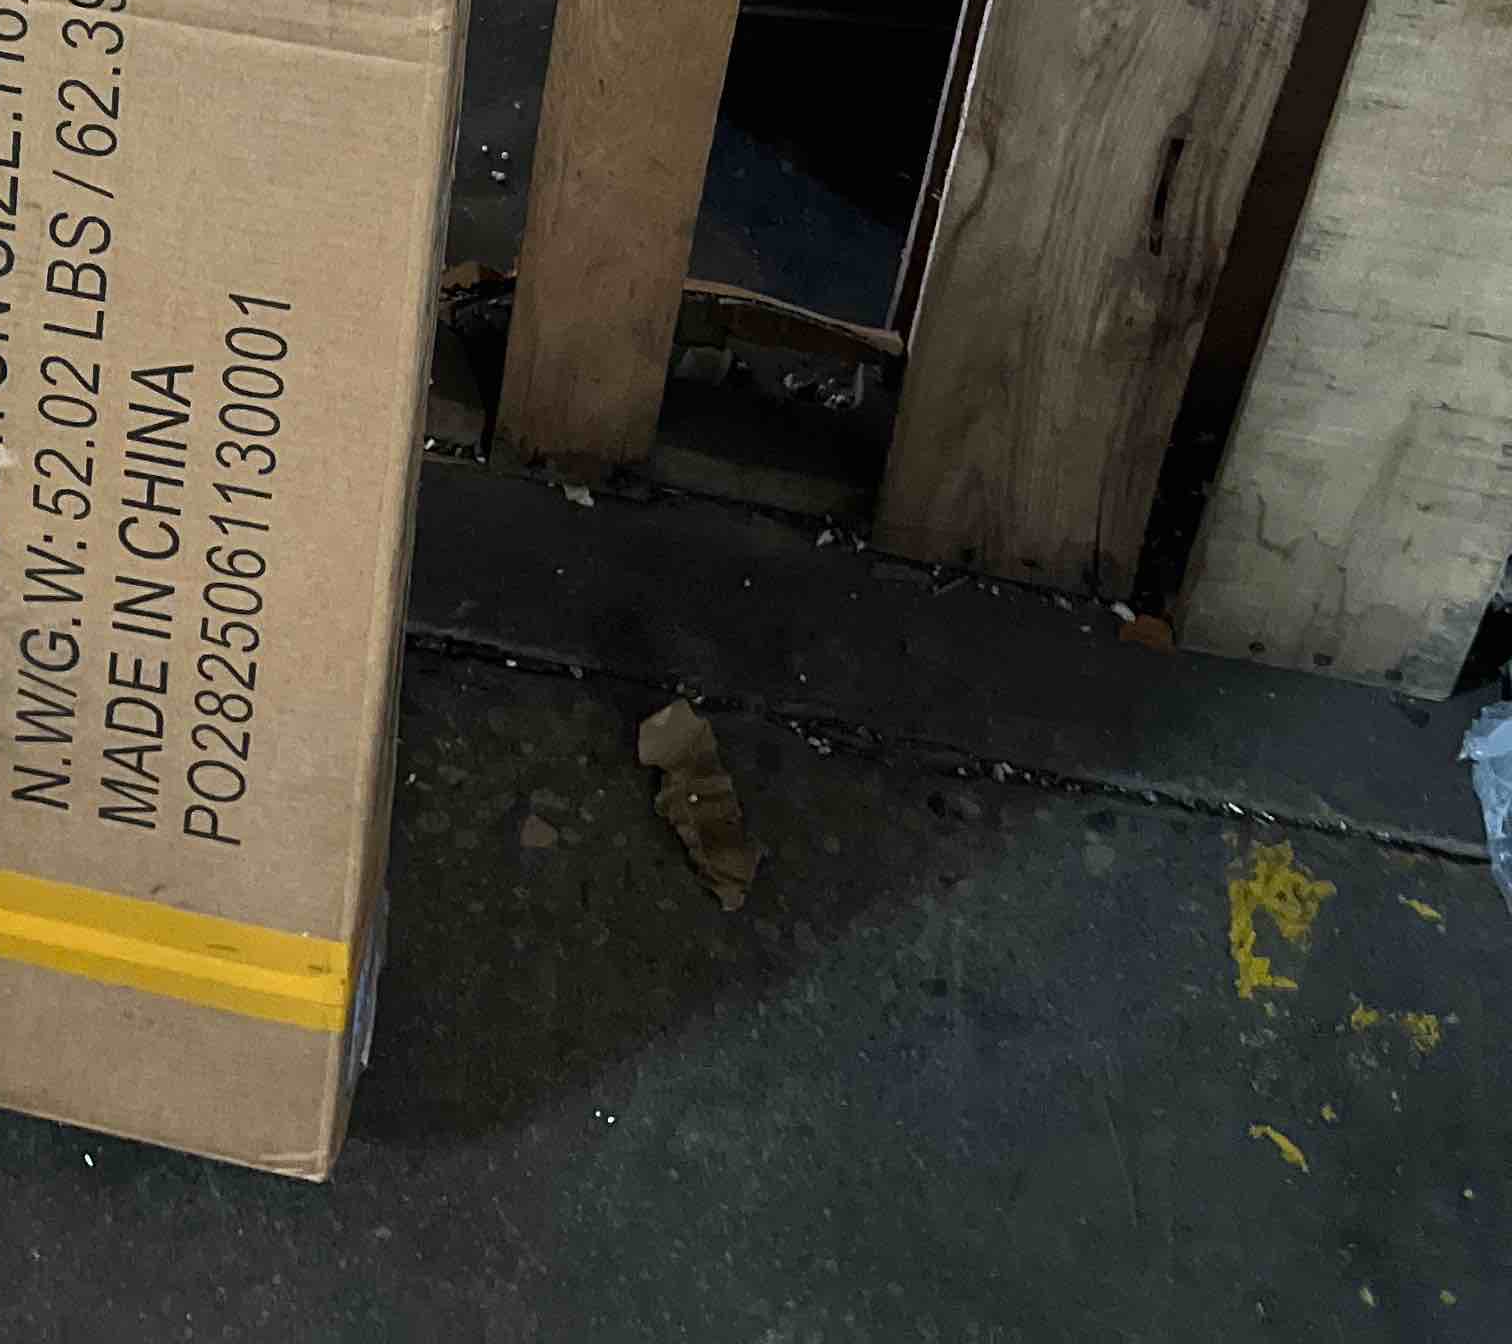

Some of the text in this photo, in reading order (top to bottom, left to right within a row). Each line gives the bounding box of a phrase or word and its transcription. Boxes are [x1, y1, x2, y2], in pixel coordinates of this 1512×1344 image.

[43, 211, 113, 341] LBS
[98, 362, 195, 830] MADE IN CHINA
[184, 292, 292, 846] PO2825061130001
